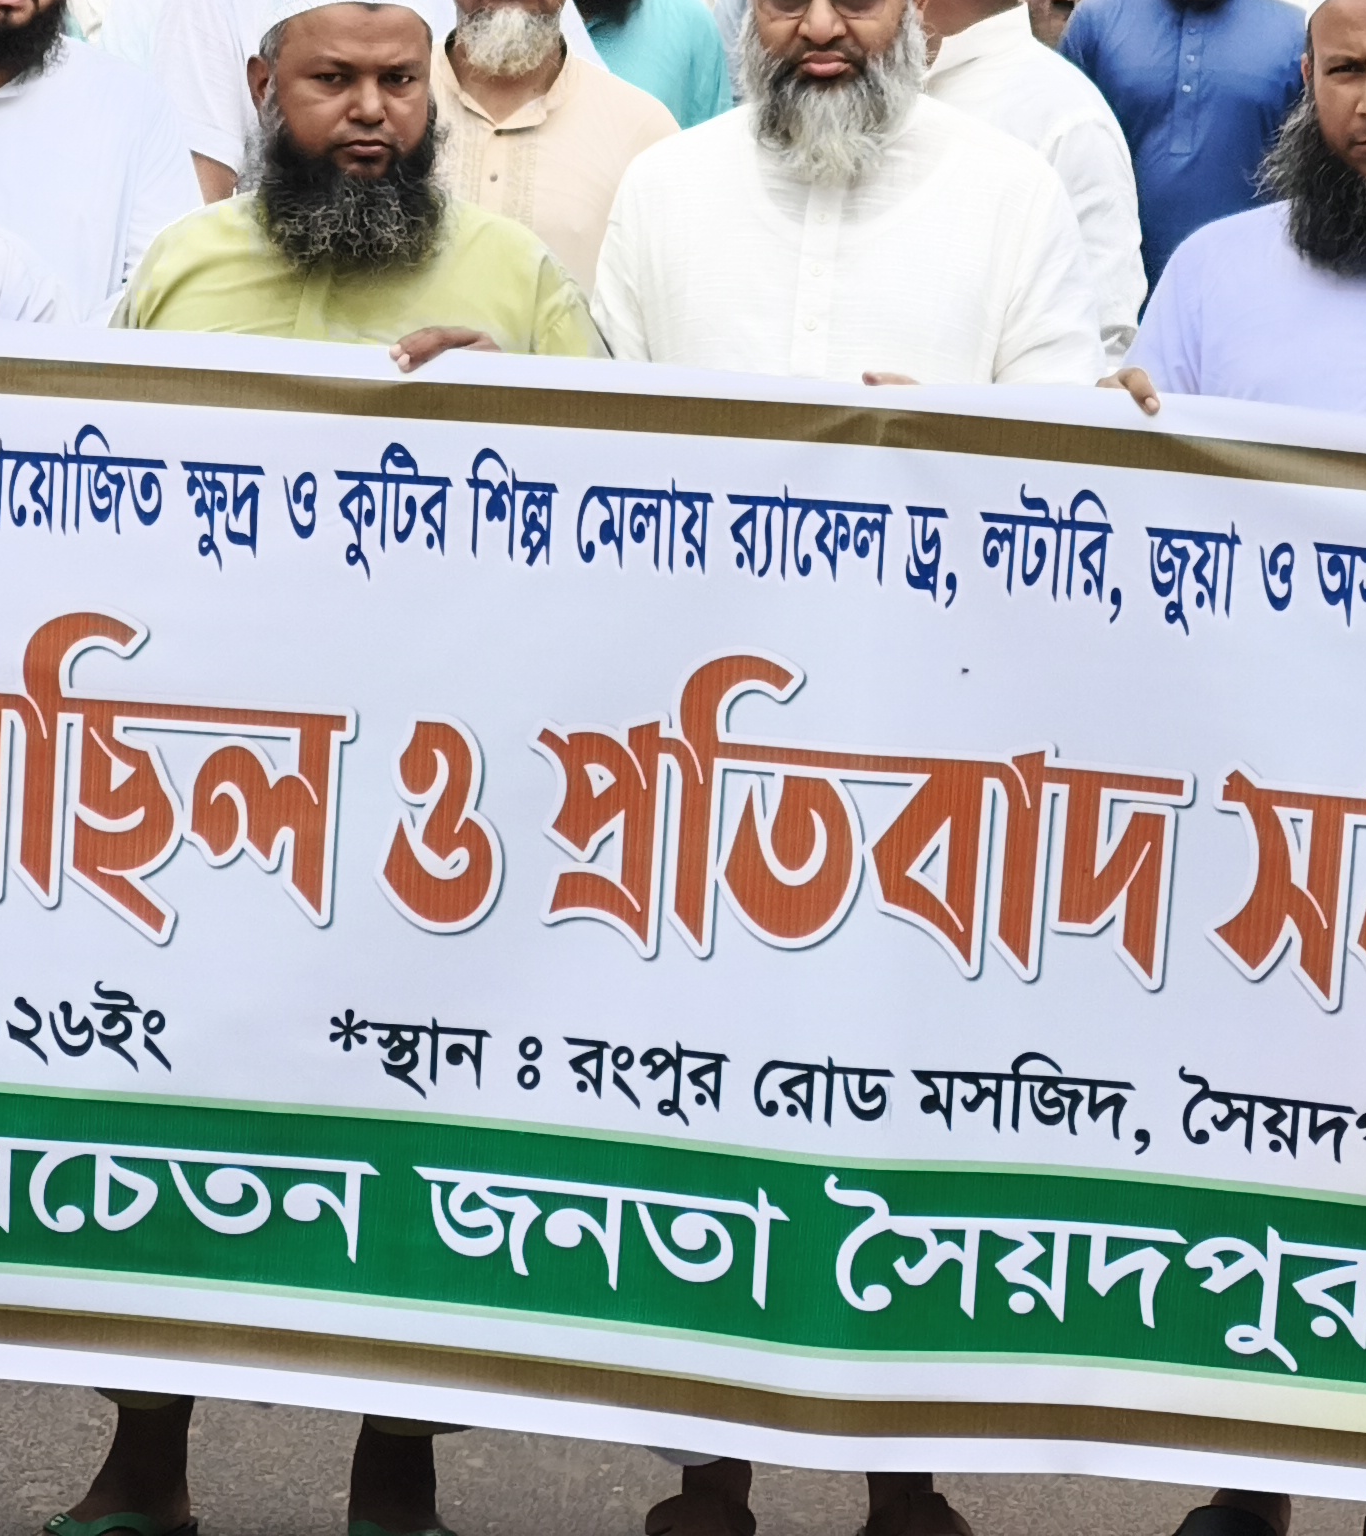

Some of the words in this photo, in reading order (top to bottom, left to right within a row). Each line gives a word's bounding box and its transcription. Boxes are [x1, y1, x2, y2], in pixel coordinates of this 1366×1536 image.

[181, 461, 265, 566] ক্ষুদ্র
[284, 472, 317, 538] ও
[335, 443, 452, 577] কুটির
[466, 448, 558, 566] শিল্প
[577, 480, 713, 571] মেলায়
[980, 484, 1121, 623] লটারি,
[1146, 523, 1241, 635] জুয়া
[1261, 543, 1294, 611] ও
[385, 723, 492, 922] ও
[541, 657, 1182, 973] প্রতিবাদ
[564, 1037, 729, 1125] রংপুর
[754, 1057, 893, 1125] রোড
[912, 1052, 1150, 1155] মসজিদ,
[407, 1167, 788, 1317] জনতা
